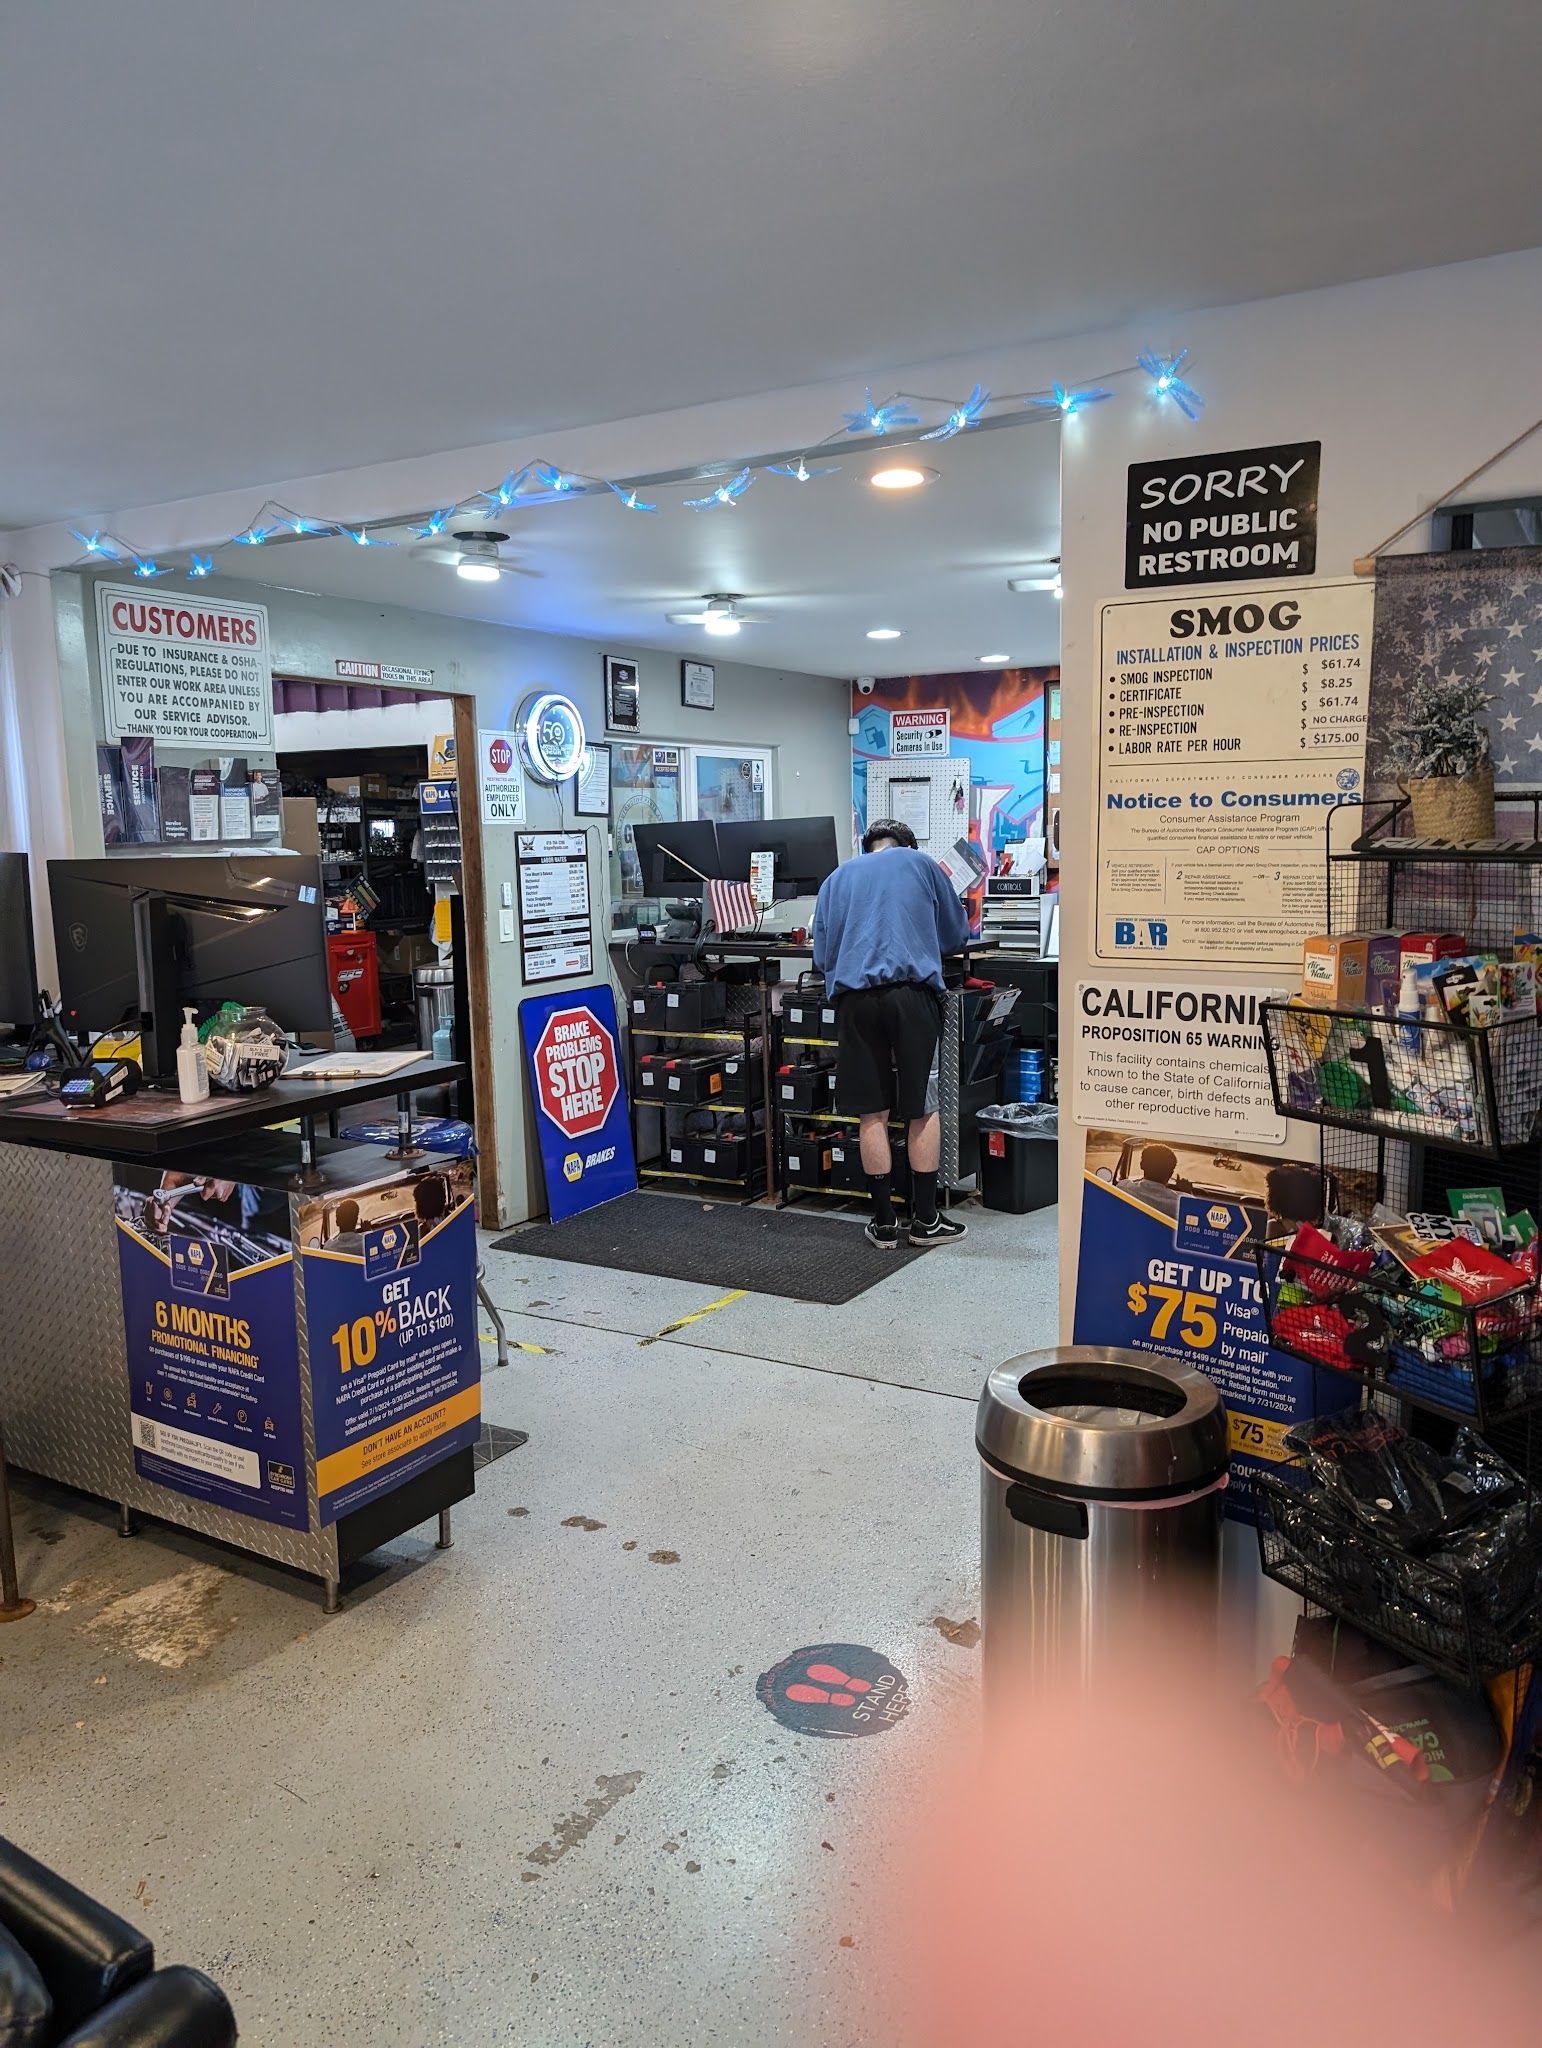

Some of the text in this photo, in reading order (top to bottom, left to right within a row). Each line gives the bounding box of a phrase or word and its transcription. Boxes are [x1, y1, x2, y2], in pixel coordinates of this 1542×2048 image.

[1141, 459, 1304, 510] SORRY
[1143, 508, 1298, 544] NO PUBLIC
[1138, 541, 1299, 576] RESTROOM
[112, 602, 257, 646] CUSTOMERS
[1170, 601, 1301, 638] SMOG
[117, 643, 257, 667] DUE TO INSURANCE & OSHA
[1116, 634, 1359, 665] INSTALLATION & INSPECTION PRICES
[116, 658, 259, 682] REGULATIONS, PLEASE DO NOT
[339, 662, 378, 677] CAUTION
[382, 666, 412, 674] OCCASIONAL
[1321, 658, 1361, 670] $61.74
[117, 674, 260, 697] ENTER OUR WORK AREA UNLESS
[1120, 668, 1213, 684] SMOG INSPECTION
[1320, 678, 1353, 689] $8.25
[120, 691, 260, 712] YOU ARE ACCOMPANIED BY
[1120, 688, 1182, 701] CERTIFICATE
[1319, 696, 1358, 707] $61.74
[134, 708, 250, 726] OUR SERVICE ADVISOR.
[896, 714, 944, 726] WARNING
[1119, 705, 1204, 720] PRE-INSPECTION
[1313, 714, 1367, 724] NO CHARGE
[127, 723, 258, 739] THANK YOU FOR YOUR COOPERATION
[897, 730, 923, 741] Security
[1119, 722, 1197, 737] RE-INSPECTION
[1313, 733, 1359, 744] $175.00
[897, 742, 942, 753] Cameras In Use
[1119, 738, 1241, 755] LABOR RATE PER HOUR
[492, 749, 510, 764] STOP
[132, 764, 140, 805] SERVICE
[426, 789, 436, 799] NAPA
[485, 784, 519, 793] AUTHORIZED
[104, 774, 114, 815] SERVICE
[486, 794, 519, 802] EMPLOYEES
[1107, 790, 1362, 809] Notice to Consumers
[491, 803, 516, 817] ONLY
[1160, 814, 1300, 824] Consumer Assistance Program
[1197, 846, 1260, 854] CAP OPTIONS
[997, 883, 1022, 891] CONTROLS
[1307, 961, 1320, 969] Air
[1310, 970, 1332, 980] Natur
[554, 1021, 590, 1043] BRAKE
[1082, 1026, 1180, 1044] PROPOSITION
[1186, 1032, 1202, 1045] 65
[546, 1035, 602, 1062] PROBLEMS
[1089, 1051, 1269, 1074] This facility contains chemicals
[549, 1052, 605, 1098] STOP
[1087, 1066, 1270, 1090] known to the State of California
[1080, 1081, 1251, 1104] to cause cancer, birth defects
[561, 1087, 604, 1122] HERE
[1105, 1099, 1248, 1120] other reproductive harm.
[566, 1147, 615, 1175] NAPA BRAKES
[1210, 1212, 1228, 1223] NAPA
[383, 1234, 397, 1244] NAPA
[1148, 1259, 1270, 1302] GET UP TO
[382, 1277, 410, 1304] GET
[155, 1300, 251, 1349] 6 MONTHS
[1127, 1282, 1218, 1348] $75
[332, 1285, 451, 1373] 10% BACK
[399, 1314, 454, 1348] (UP TO $100)
[152, 1330, 209, 1356] PROMOTIONAL
[1221, 1342, 1235, 1357] by
[1257, 1398, 1294, 1413] 7/31/2024.
[363, 1408, 446, 1456] DON'T HAVE AN ACCOUNT?
[1233, 1419, 1263, 1444] $75
[852, 1675, 896, 1722] STAND
